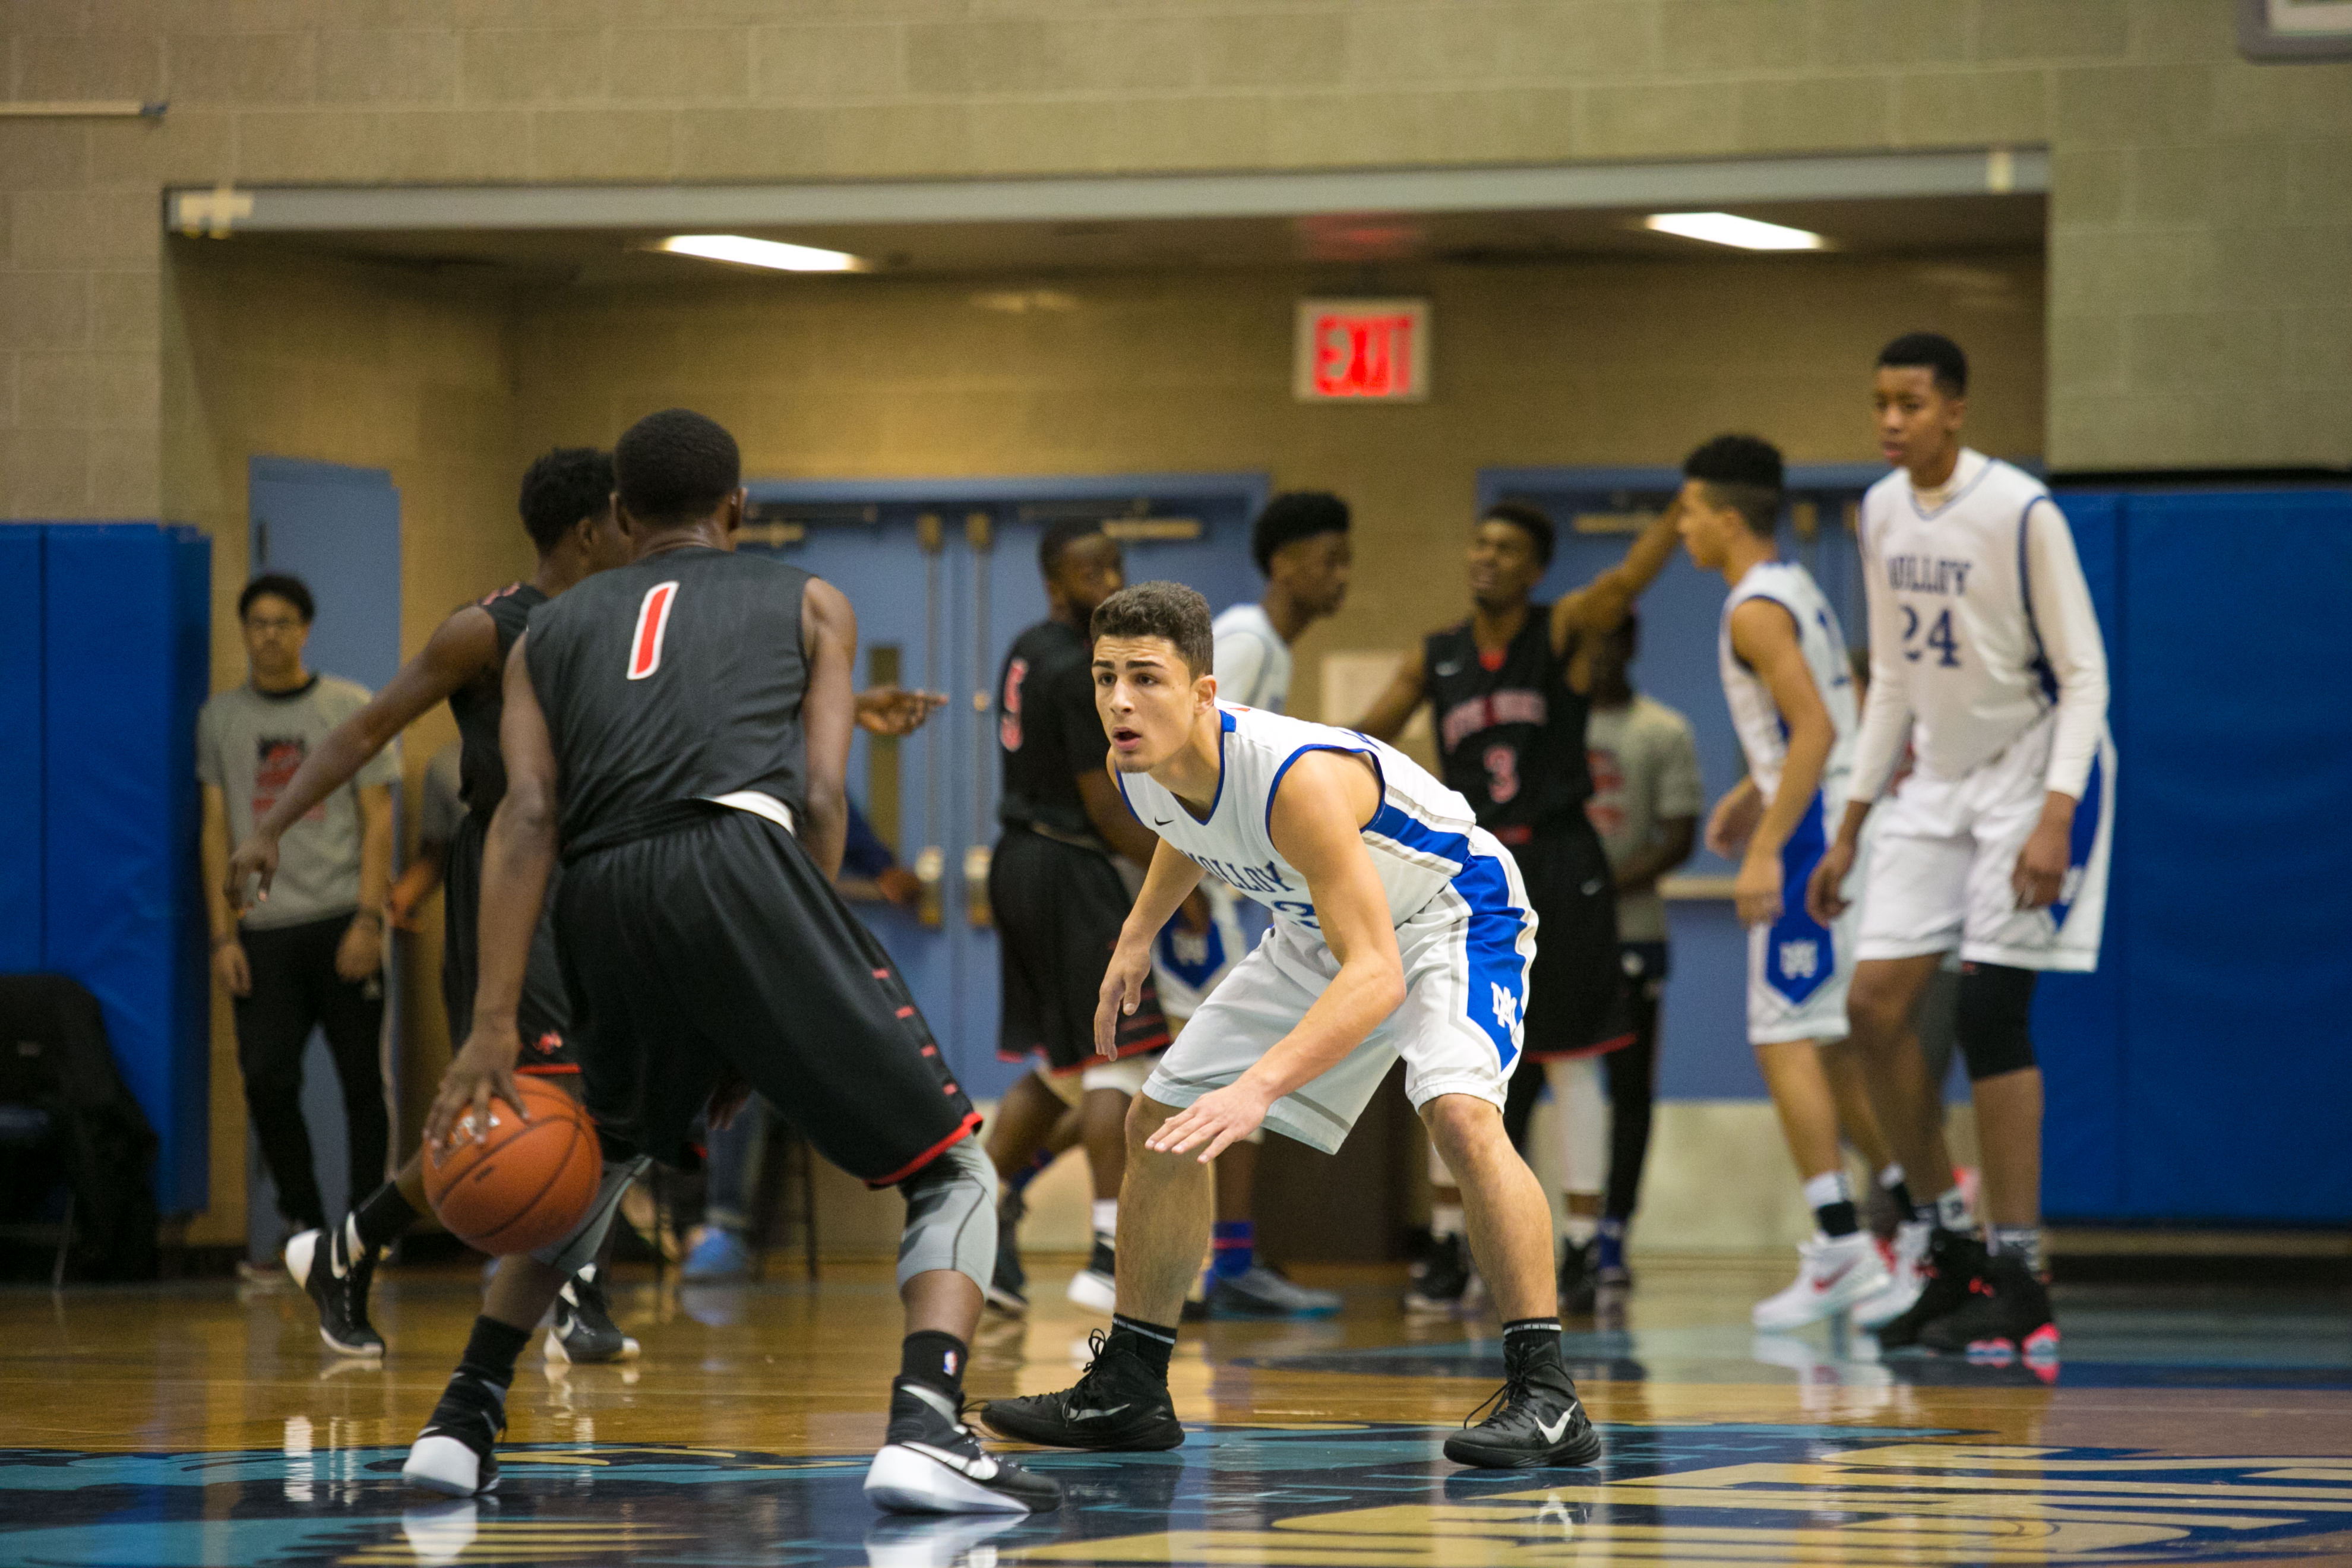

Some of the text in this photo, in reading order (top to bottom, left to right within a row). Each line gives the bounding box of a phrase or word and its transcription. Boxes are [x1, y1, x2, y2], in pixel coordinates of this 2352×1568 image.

[1314, 314, 1413, 397] EXIT
[627, 580, 680, 680] 1
[1898, 603, 1961, 668] 24
[1484, 745, 1519, 804] 3
[1178, 849, 1297, 893] OLLOY
